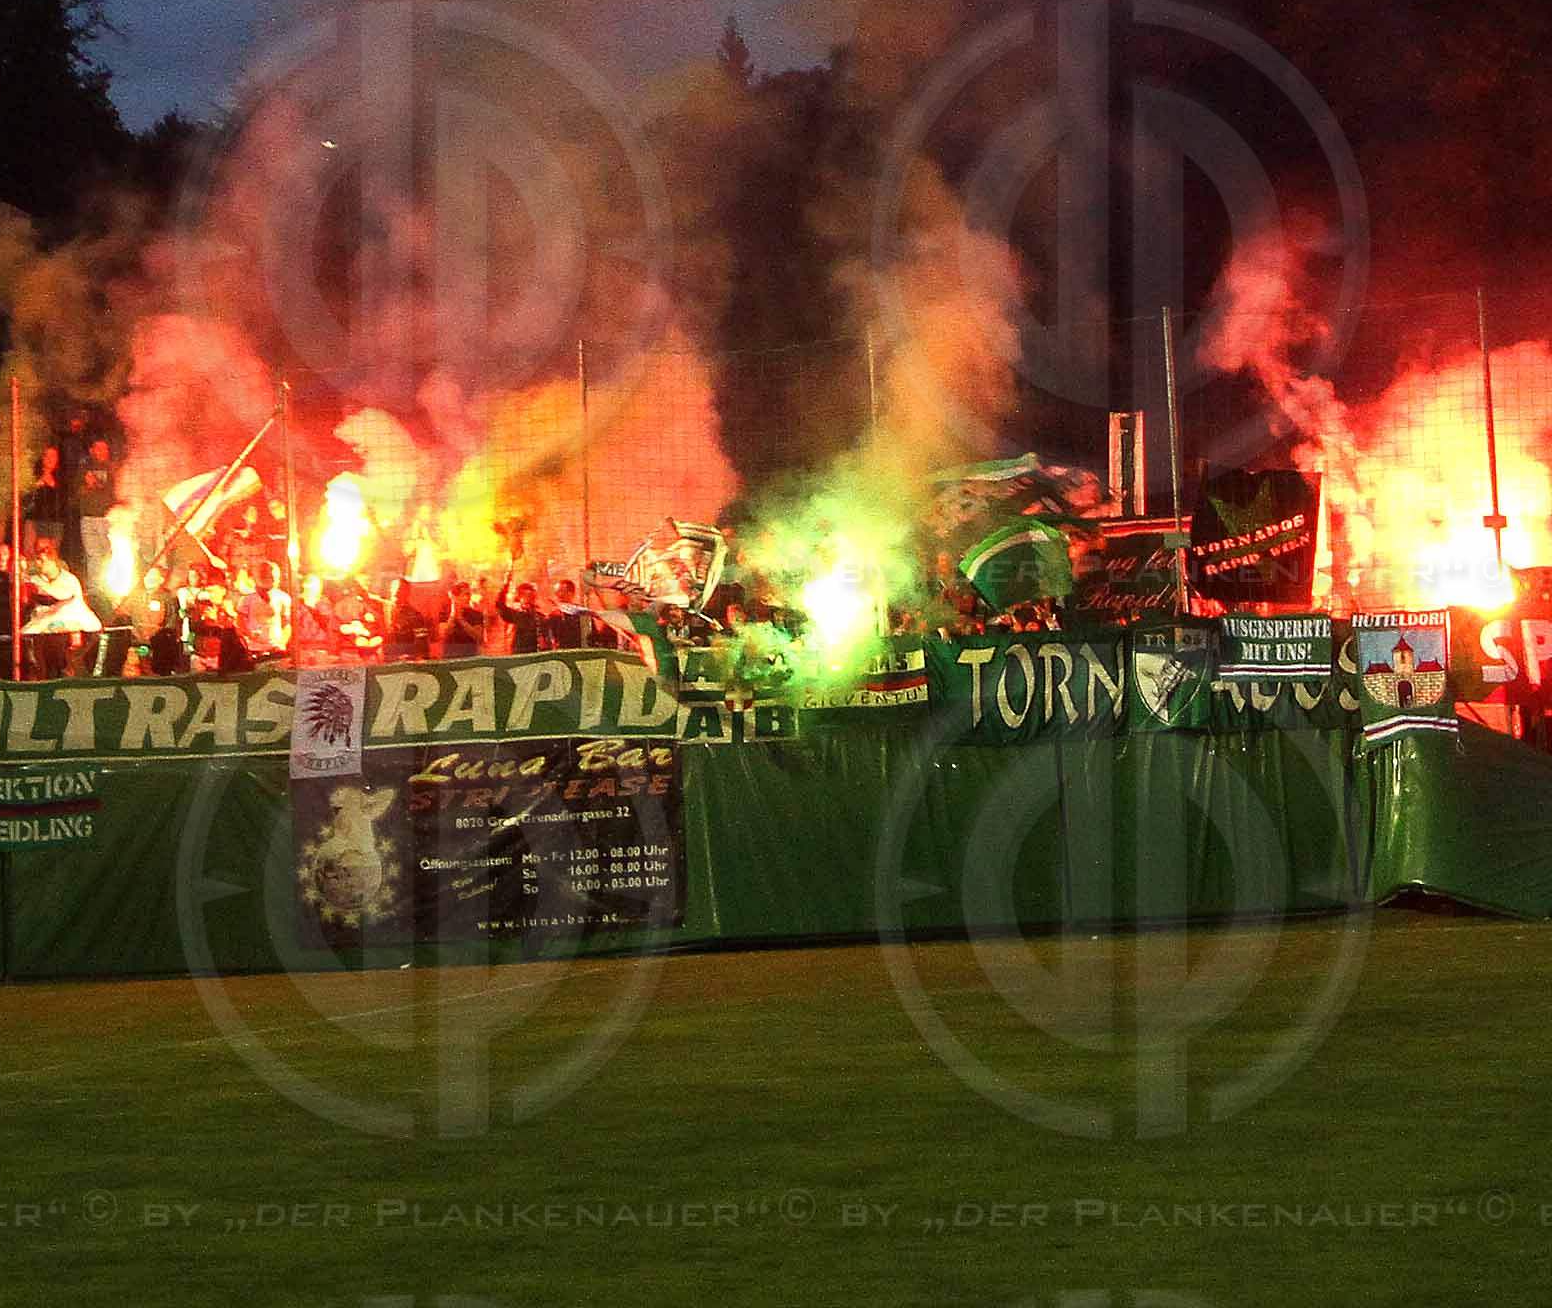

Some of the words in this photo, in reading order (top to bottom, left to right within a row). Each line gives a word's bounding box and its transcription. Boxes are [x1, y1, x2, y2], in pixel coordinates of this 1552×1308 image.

[1241, 642, 1271, 660] MIT
[1276, 641, 1313, 661] UNS!
[370, 658, 680, 738] RAPID
[407, 752, 548, 784] Luna
[576, 738, 674, 771] Bar
[643, 844, 670, 857] Uhr
[643, 859, 669, 872] Uhr
[645, 875, 671, 888] Uhr
